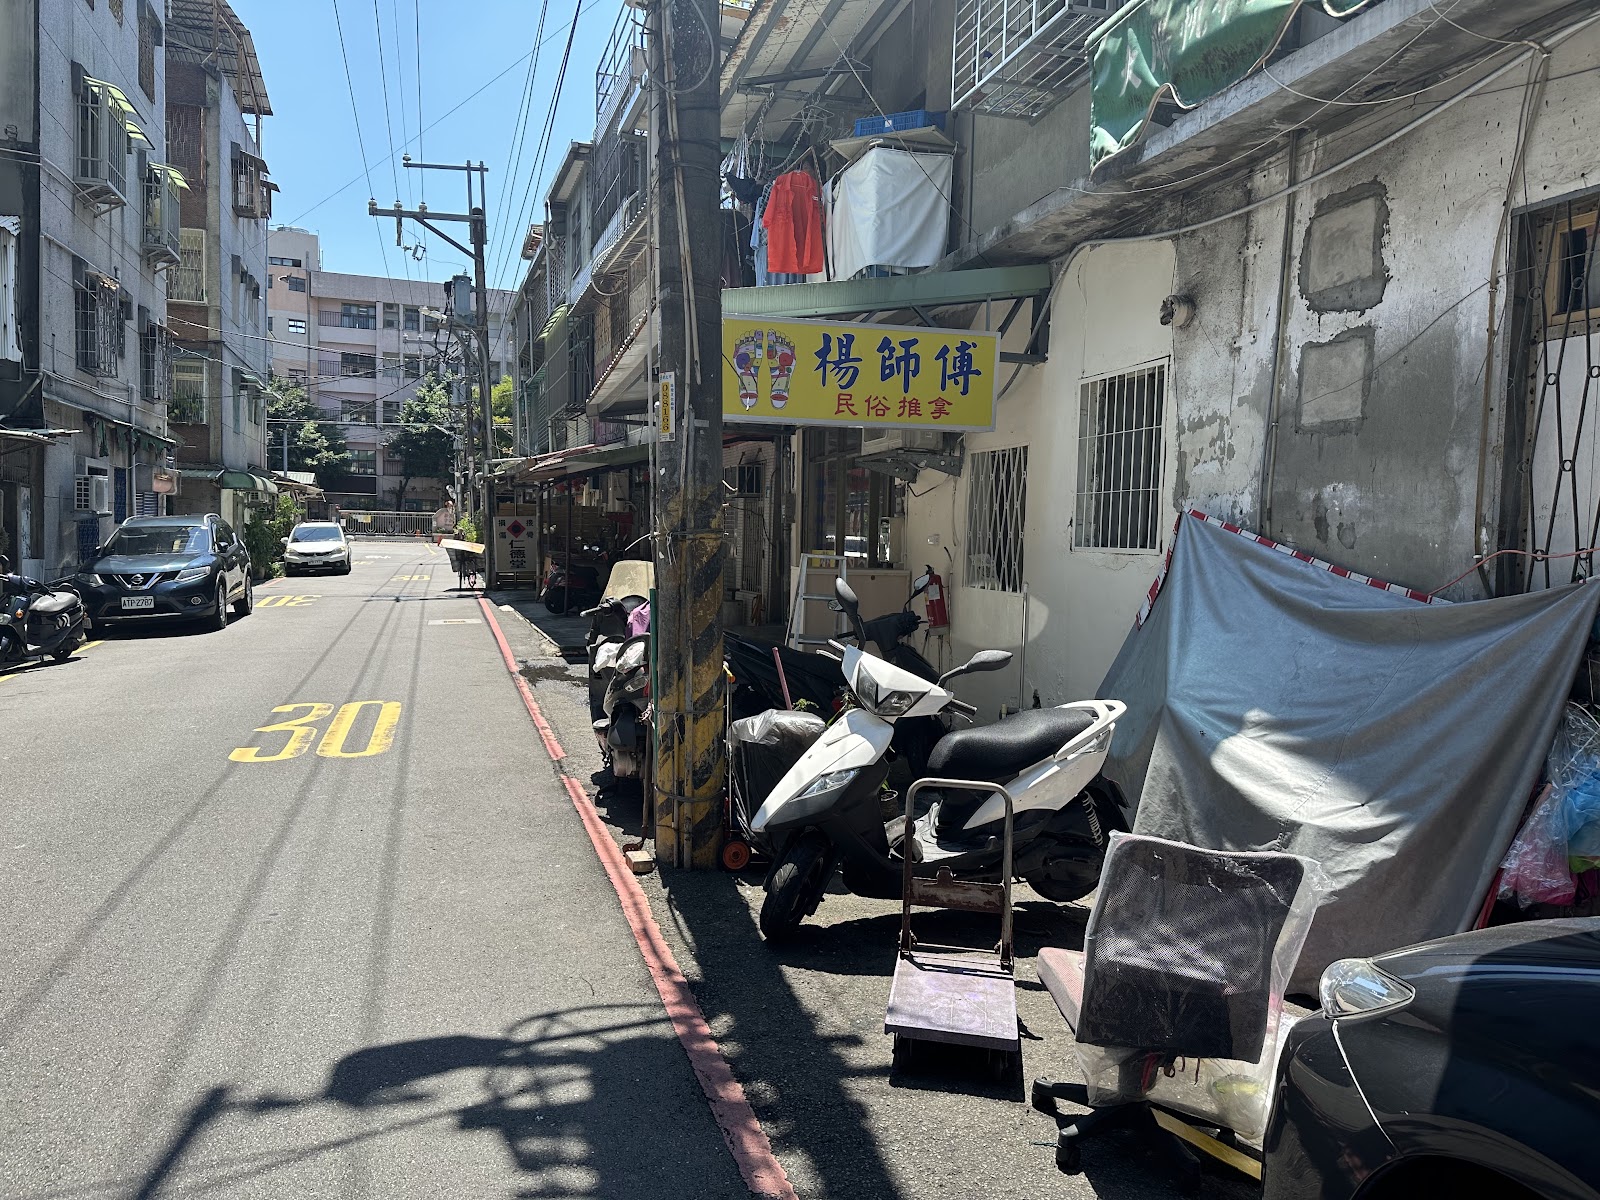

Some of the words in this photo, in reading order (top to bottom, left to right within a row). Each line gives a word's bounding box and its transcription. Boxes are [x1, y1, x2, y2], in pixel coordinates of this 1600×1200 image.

[813, 332, 982, 396] 楊師傅
[834, 392, 954, 420] 民俗推拿
[228, 700, 402, 763] 30
